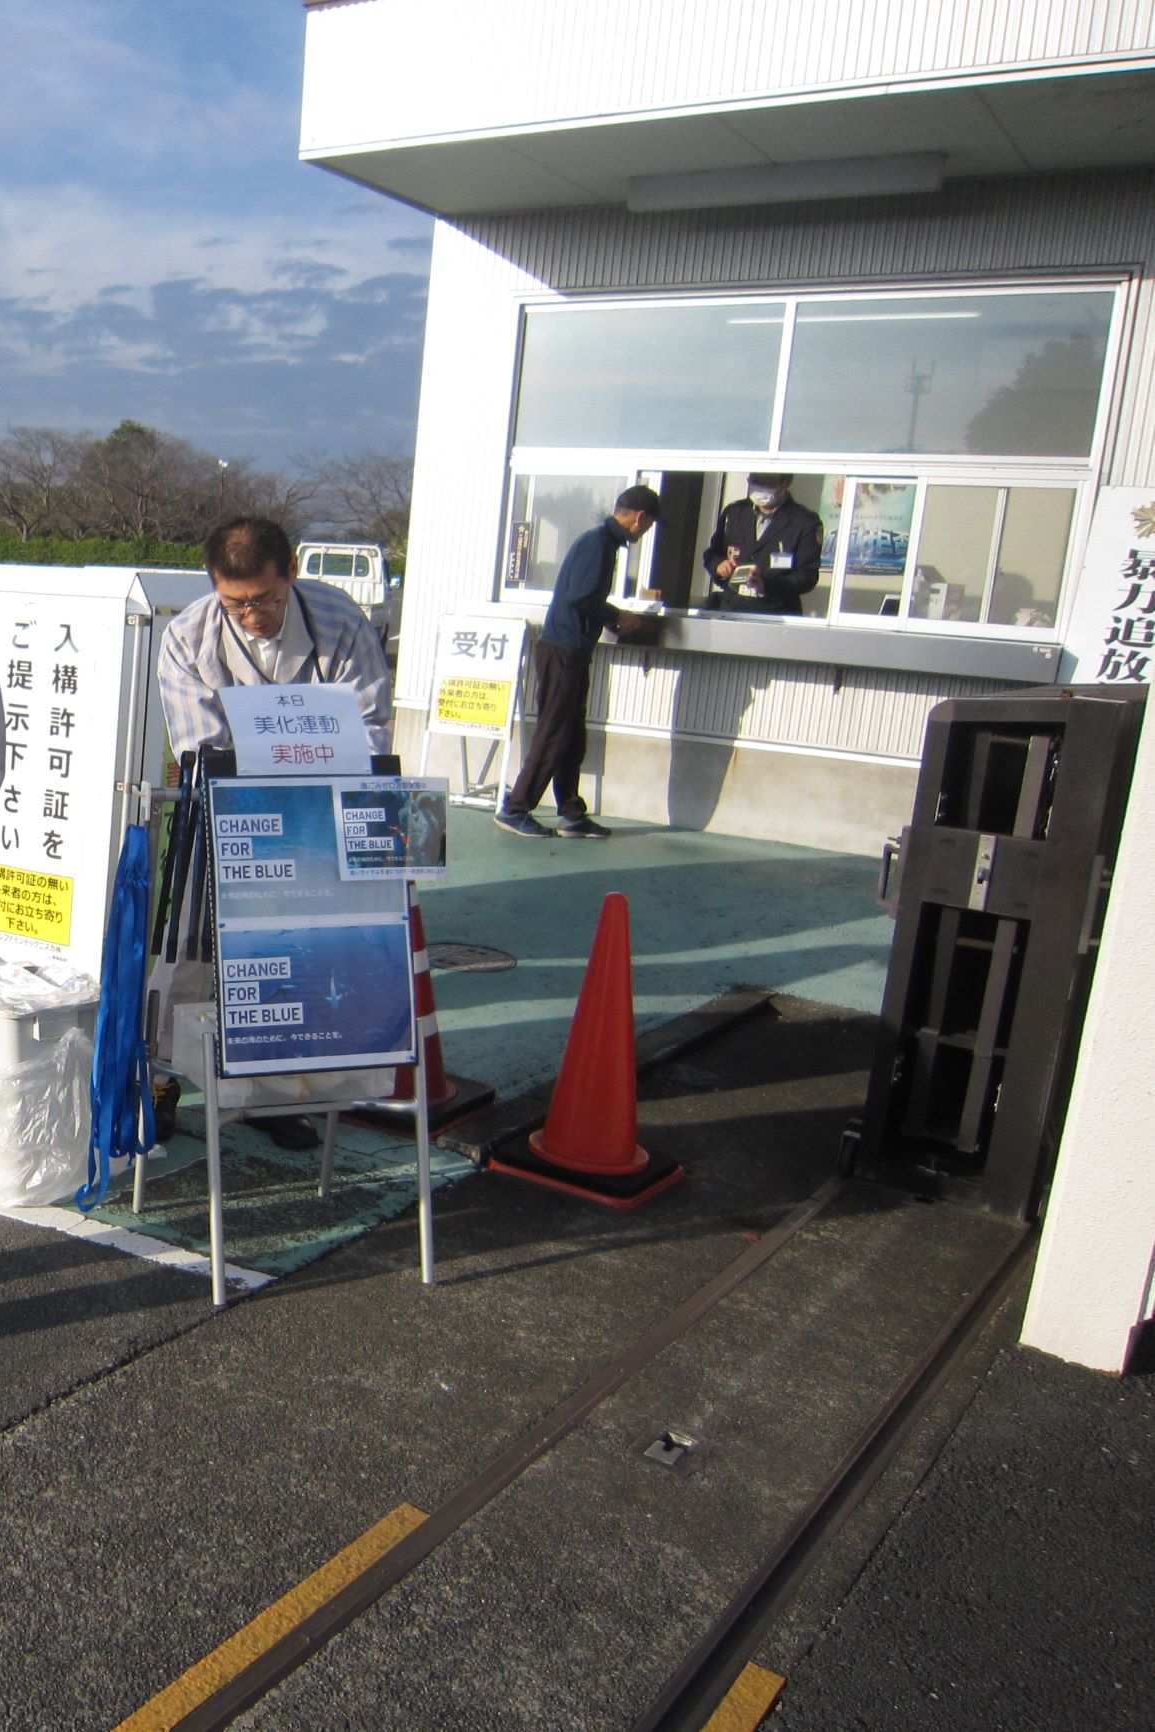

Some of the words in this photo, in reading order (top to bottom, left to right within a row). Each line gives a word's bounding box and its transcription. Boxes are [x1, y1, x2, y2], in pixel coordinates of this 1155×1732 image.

[450, 630, 510, 661] 受付
[274, 694, 305, 707] 本日
[437, 698, 497, 712] 受付にお立ち寄り
[253, 715, 340, 735] 美化運動
[1, 619, 37, 850] ご提示下さい
[42, 623, 79, 860] 入構許可証を
[270, 743, 335, 765] 実施中
[345, 810, 384, 821] CHANGE
[218, 818, 280, 833] CHANGE
[346, 825, 366, 836] FOR
[221, 842, 250, 856] FOR
[347, 840, 367, 850] THE
[368, 839, 393, 849] BLUE
[221, 865, 252, 879] THE
[255, 864, 294, 879] BLUE
[5, 916, 38, 935] 下さい。
[226, 961, 288, 978] CHANGE
[227, 986, 257, 1001] FOR
[228, 1009, 258, 1025] THE
[261, 1007, 301, 1023] BLUE
